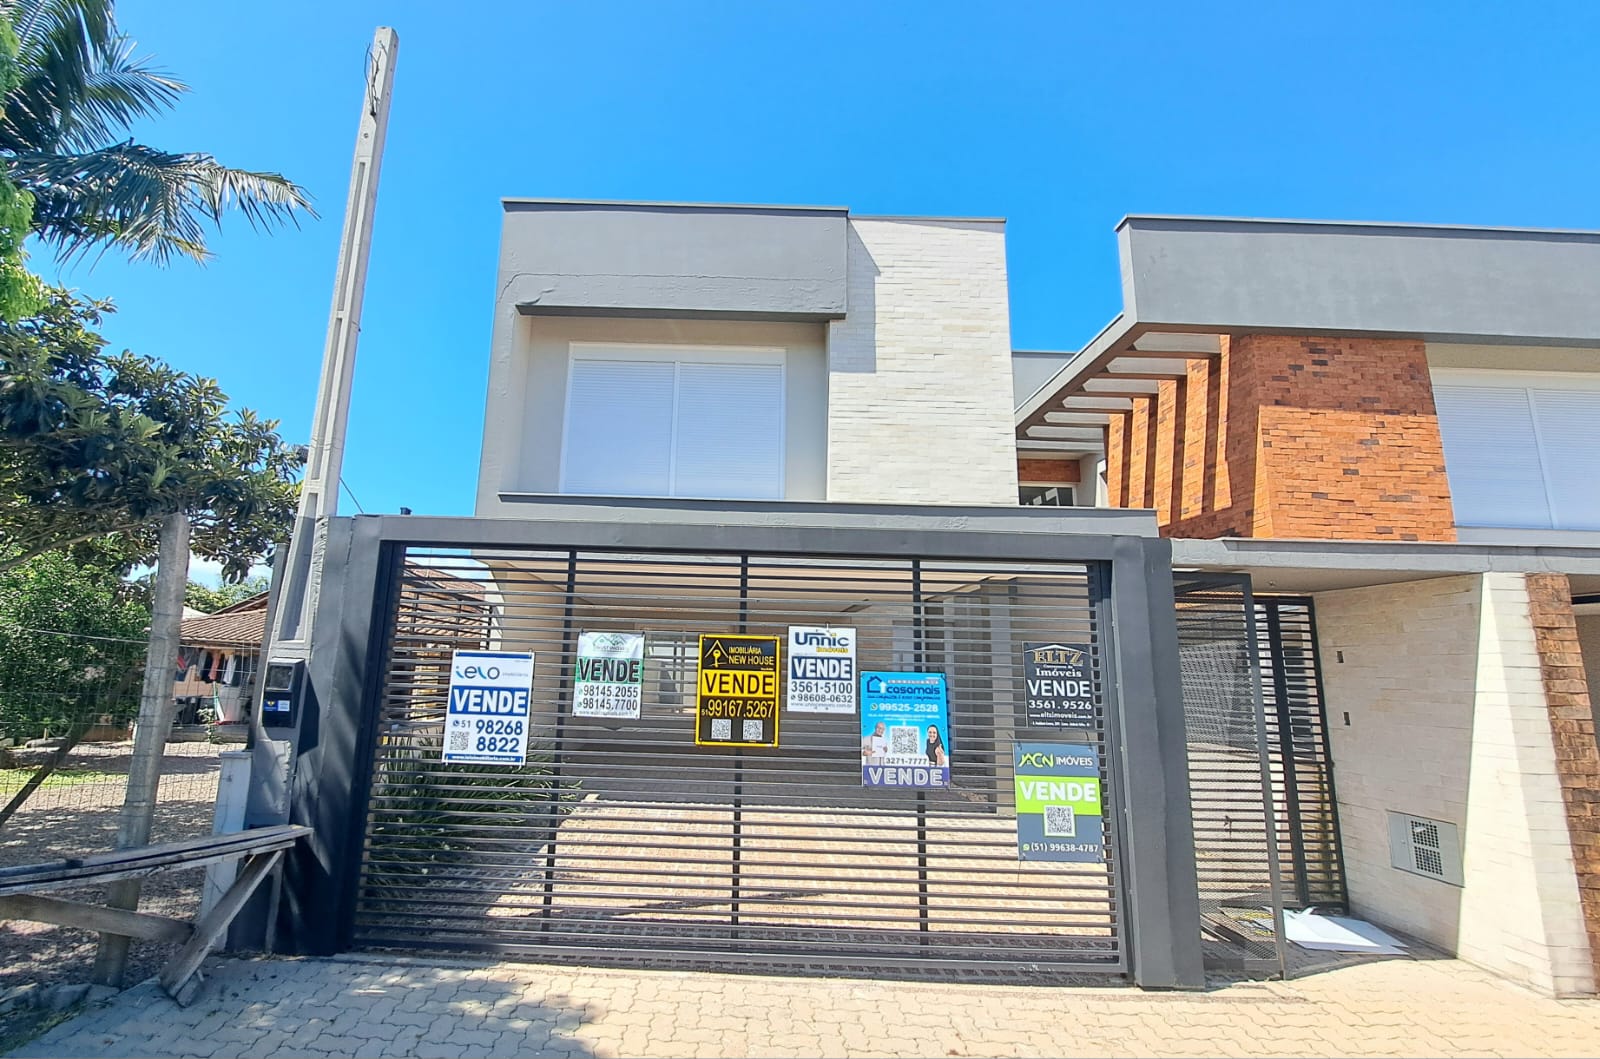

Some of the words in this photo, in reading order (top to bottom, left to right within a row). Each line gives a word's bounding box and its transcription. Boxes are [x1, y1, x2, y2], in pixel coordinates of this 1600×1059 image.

[795, 632, 849, 647] Unnic
[728, 656, 746, 665] NEW
[747, 656, 774, 666] HOUSE
[1033, 650, 1084, 666] ELTZ
[579, 658, 639, 682] VENDE
[793, 658, 851, 679] VENDE
[1035, 667, 1082, 677] Imóveis
[584, 685, 638, 698] 98145.2055
[705, 673, 773, 695] VENDE
[791, 681, 852, 694] 3561-5100
[886, 685, 940, 695] casamais
[1027, 679, 1091, 697] VENDE
[453, 689, 527, 714] VENDE
[582, 698, 638, 711] 98145.7700
[797, 694, 852, 703] 98608-0632
[708, 699, 774, 718] 99167.5267
[461, 720, 471, 728] 51
[476, 719, 523, 735] 98268
[476, 736, 520, 753] 8822
[886, 757, 928, 765] 3271-7777
[1055, 756, 1093, 766] IMÓVEIS
[868, 767, 943, 786] VENDE
[1019, 781, 1097, 802] VENDE
[1031, 843, 1048, 852] (51)
[1050, 843, 1099, 853] 99638-4787
